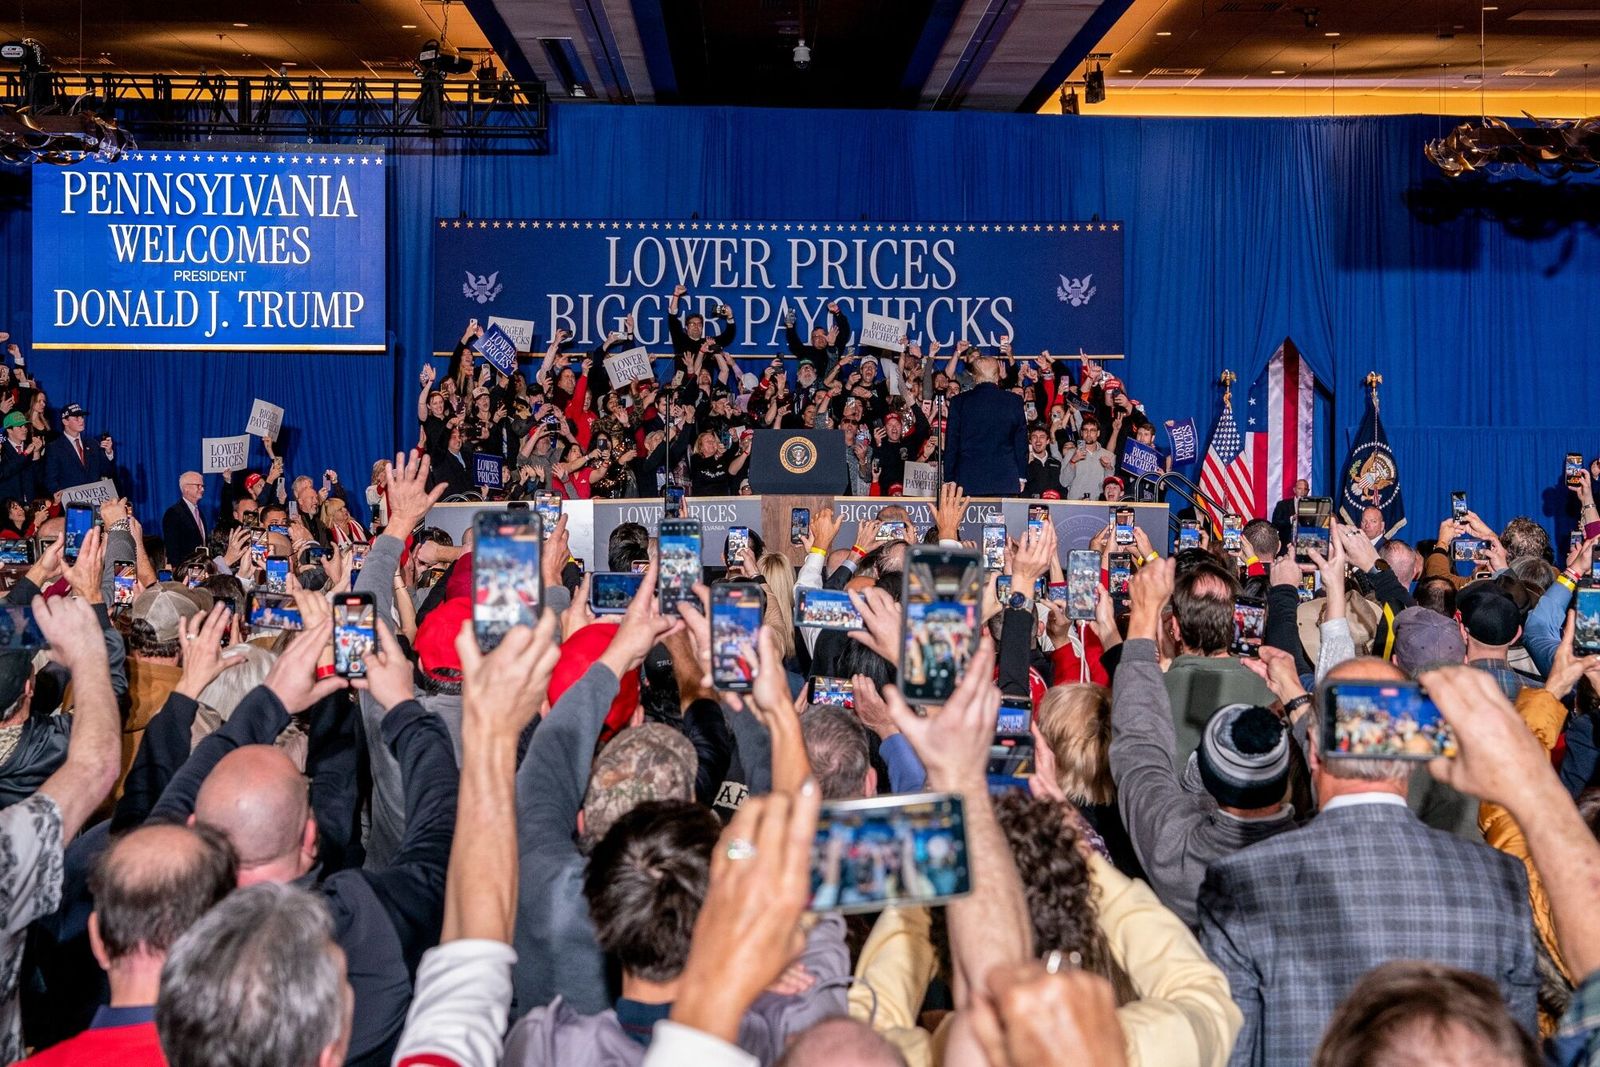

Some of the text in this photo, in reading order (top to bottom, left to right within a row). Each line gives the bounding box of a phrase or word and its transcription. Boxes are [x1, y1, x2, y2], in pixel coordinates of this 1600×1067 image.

[61, 171, 358, 217] PENNSYLVANIA
[108, 224, 311, 264] WELCOMES
[605, 236, 957, 290] LOWER PRICES
[173, 270, 247, 282] PRESIDENT
[53, 289, 365, 338] DONALD J. TRUMP
[871, 321, 900, 335] BIGGER
[481, 339, 512, 369] PRICES
[490, 331, 517, 361] LOWER
[612, 353, 645, 372] LOWER
[616, 364, 648, 383] PRICES
[210, 441, 244, 457] LOWER
[1171, 426, 1185, 461] LOWER
[1181, 424, 1195, 460] PRICES
[210, 453, 244, 468] PRICES
[1131, 446, 1158, 464] BIGGER
[477, 459, 499, 473] LOWER
[913, 469, 939, 481] BIGGE
[477, 470, 500, 485] PRICES
[67, 486, 109, 502] LOWER
[618, 504, 738, 525] LOWE RICES
